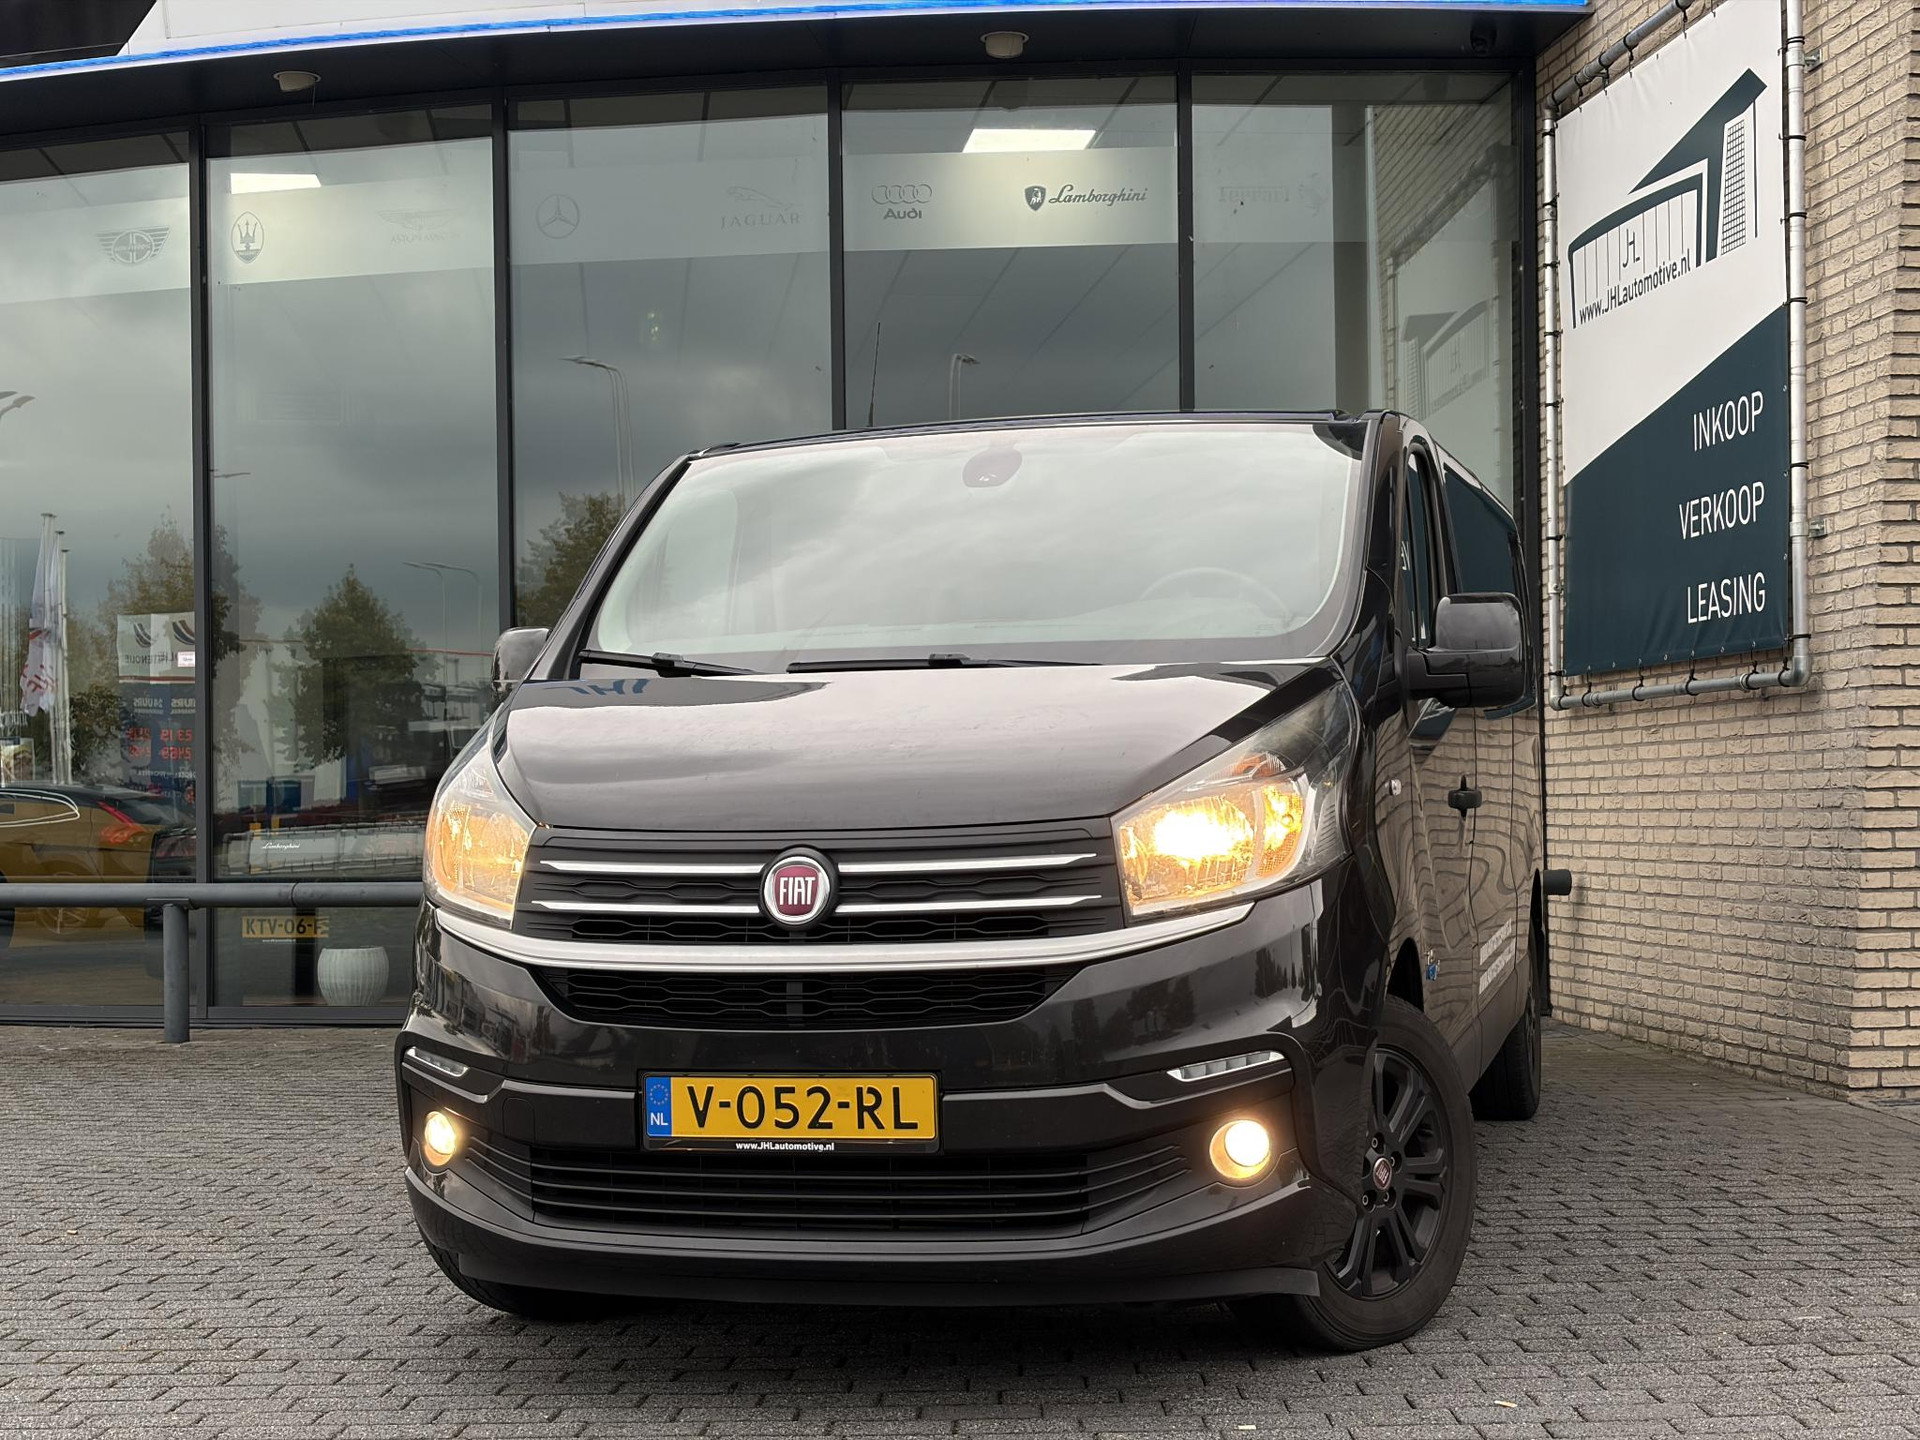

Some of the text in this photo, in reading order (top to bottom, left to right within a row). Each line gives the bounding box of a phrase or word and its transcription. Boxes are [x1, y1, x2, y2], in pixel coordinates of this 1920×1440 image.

[1049, 184, 1149, 206] Lamborghini
[720, 213, 800, 231] JAGUAR
[883, 208, 923, 220] Audi
[1579, 248, 1691, 325] www.JHLautomotive.nl
[1693, 390, 1764, 452] INKOOP
[1679, 481, 1765, 540] VERKOOP
[1687, 571, 1766, 624] LEASING
[779, 876, 816, 906] FIAT
[650, 1112, 668, 1126] NL
[687, 1086, 919, 1130] V-052-RL
[736, 1141, 835, 1151] www.JHLautomotive.nl
